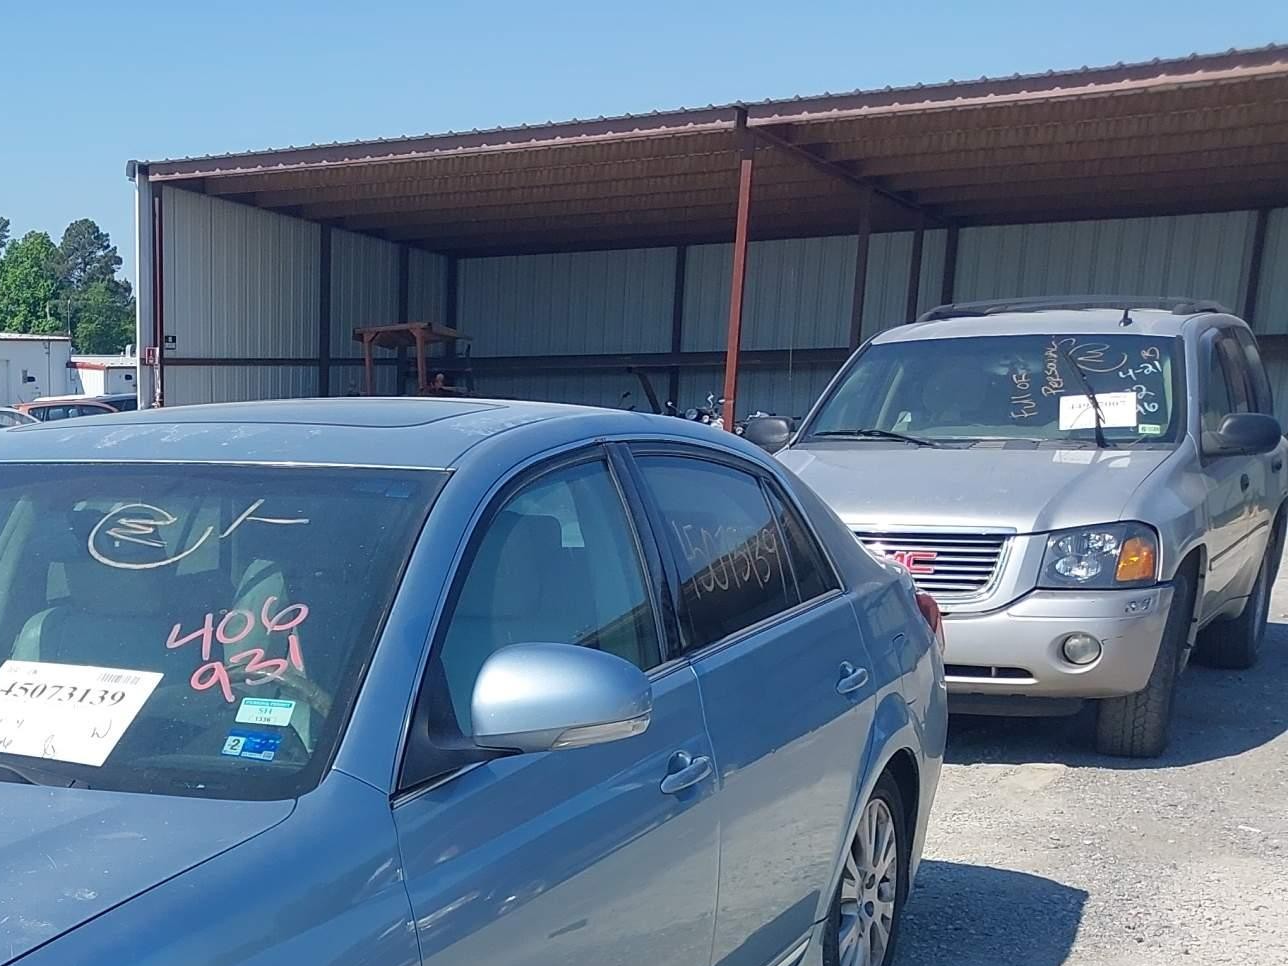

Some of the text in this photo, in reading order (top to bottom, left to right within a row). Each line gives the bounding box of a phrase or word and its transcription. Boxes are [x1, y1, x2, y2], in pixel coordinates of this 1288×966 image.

[166, 595, 310, 662] 406
[0, 681, 126, 706] 45073139
[190, 634, 305, 703] 931
